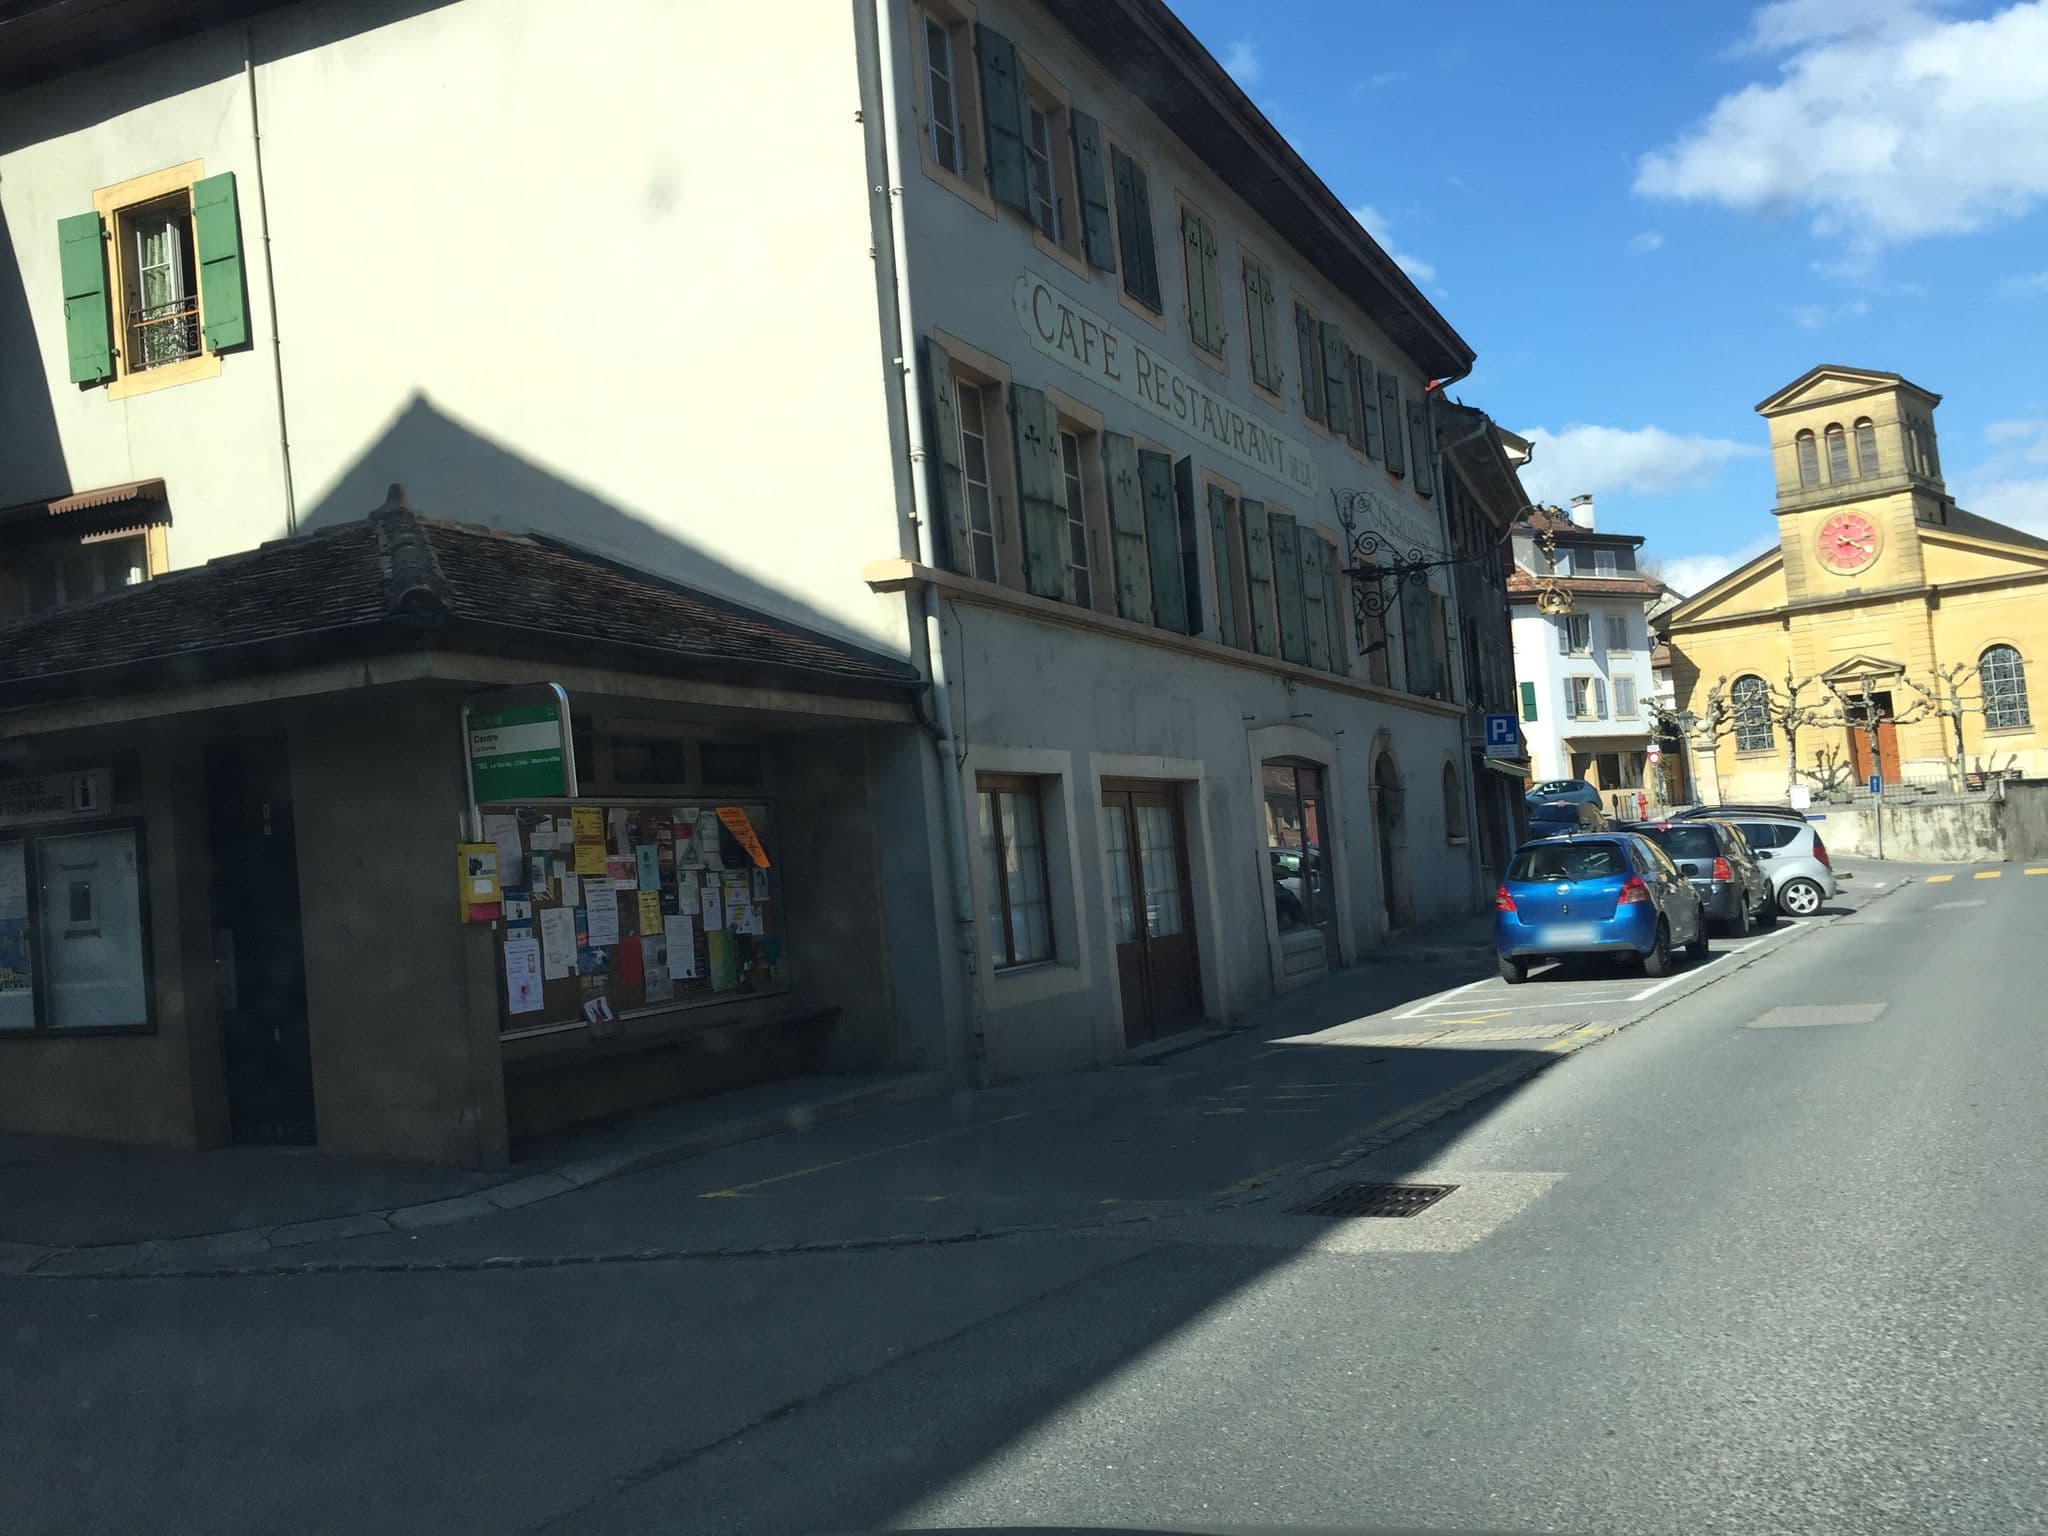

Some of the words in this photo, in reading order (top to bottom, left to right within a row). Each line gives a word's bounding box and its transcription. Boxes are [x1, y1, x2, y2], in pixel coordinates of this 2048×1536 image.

[1032, 284, 1121, 382] CAFÉ
[473, 734, 499, 744] Centre
[1492, 719, 1507, 741] P
